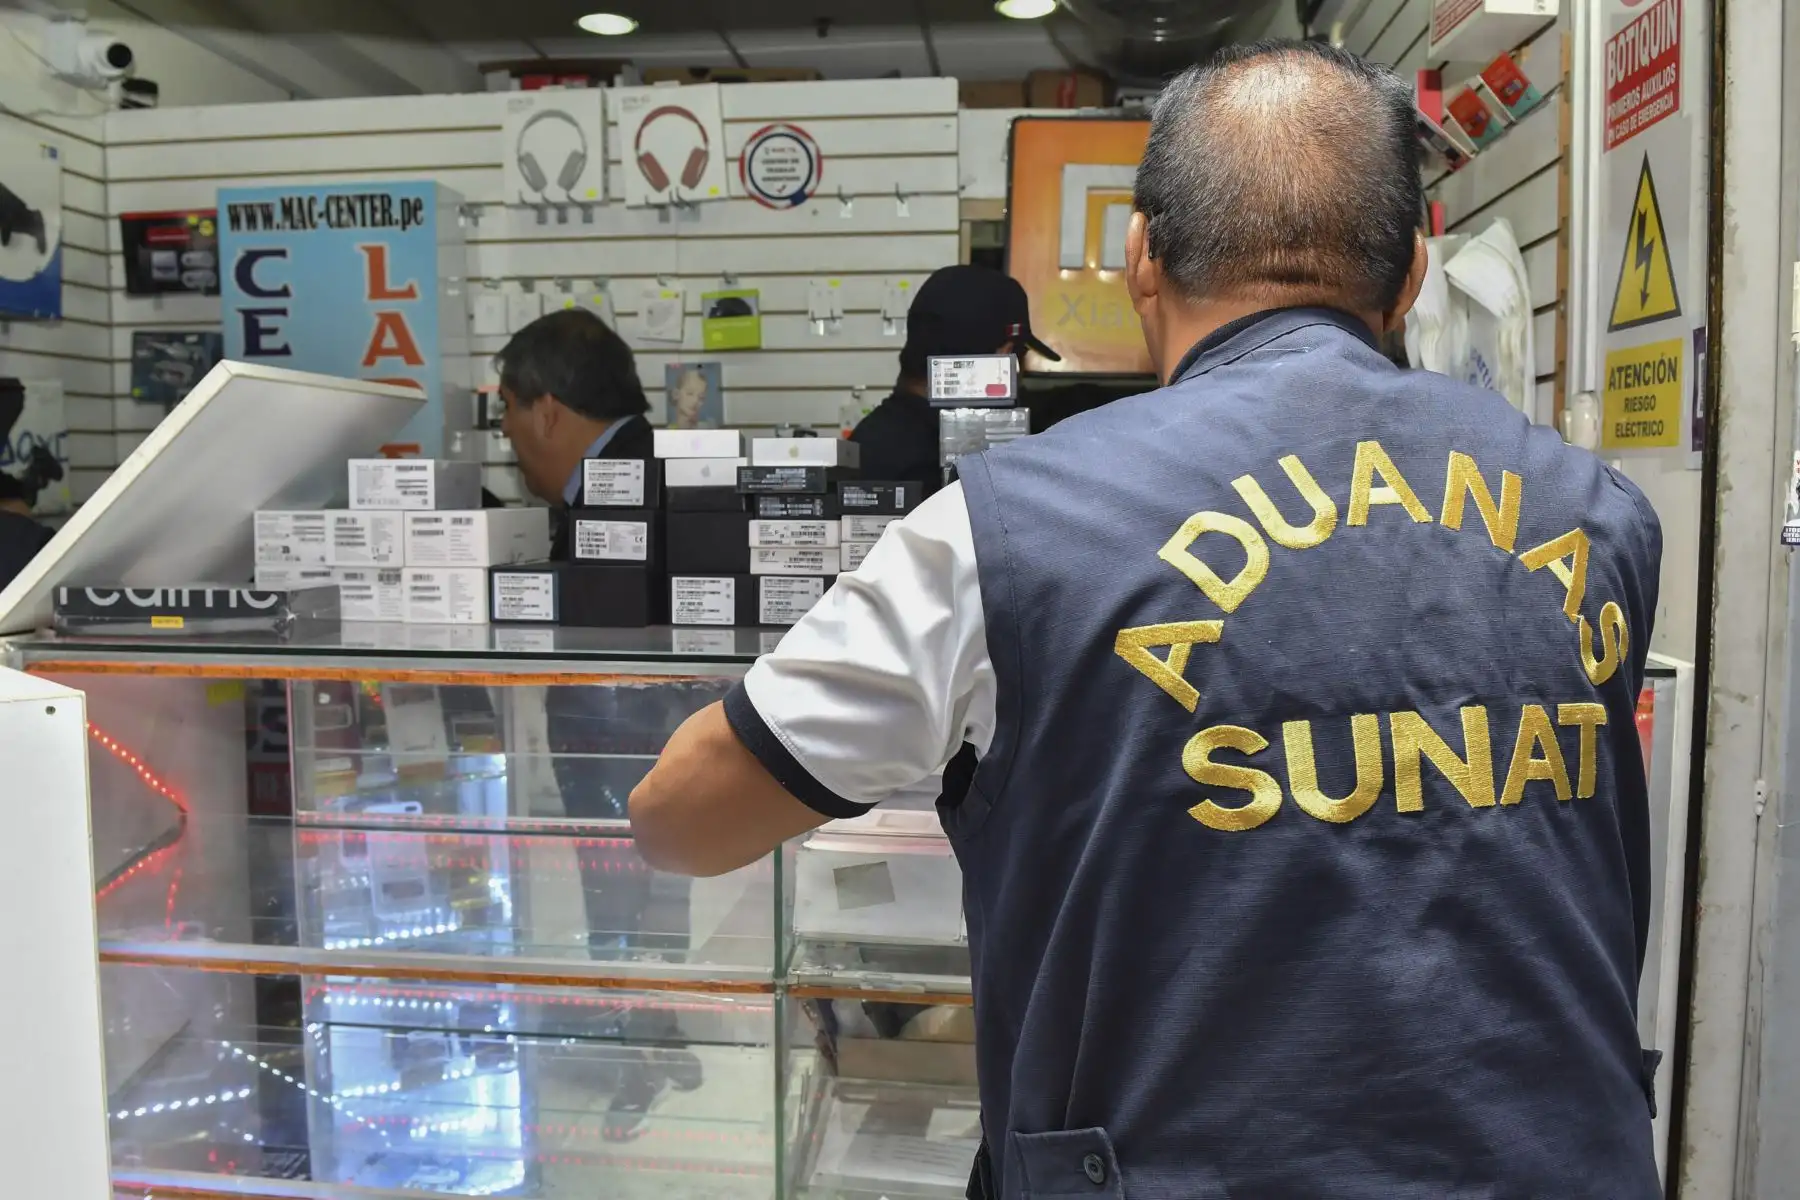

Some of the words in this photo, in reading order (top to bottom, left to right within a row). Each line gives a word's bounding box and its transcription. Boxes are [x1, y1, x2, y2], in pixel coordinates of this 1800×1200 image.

[1607, 0, 1677, 90] BOTIQUIN
[1641, 62, 1676, 102] AUXILIOS
[1608, 353, 1678, 392] ATENCIÓN
[1624, 395, 1657, 413] RIESGO
[1615, 418, 1664, 438] ELÉCTRICO
[1115, 441, 1629, 713] ADUANAS
[1182, 704, 1607, 831] SUNAT
